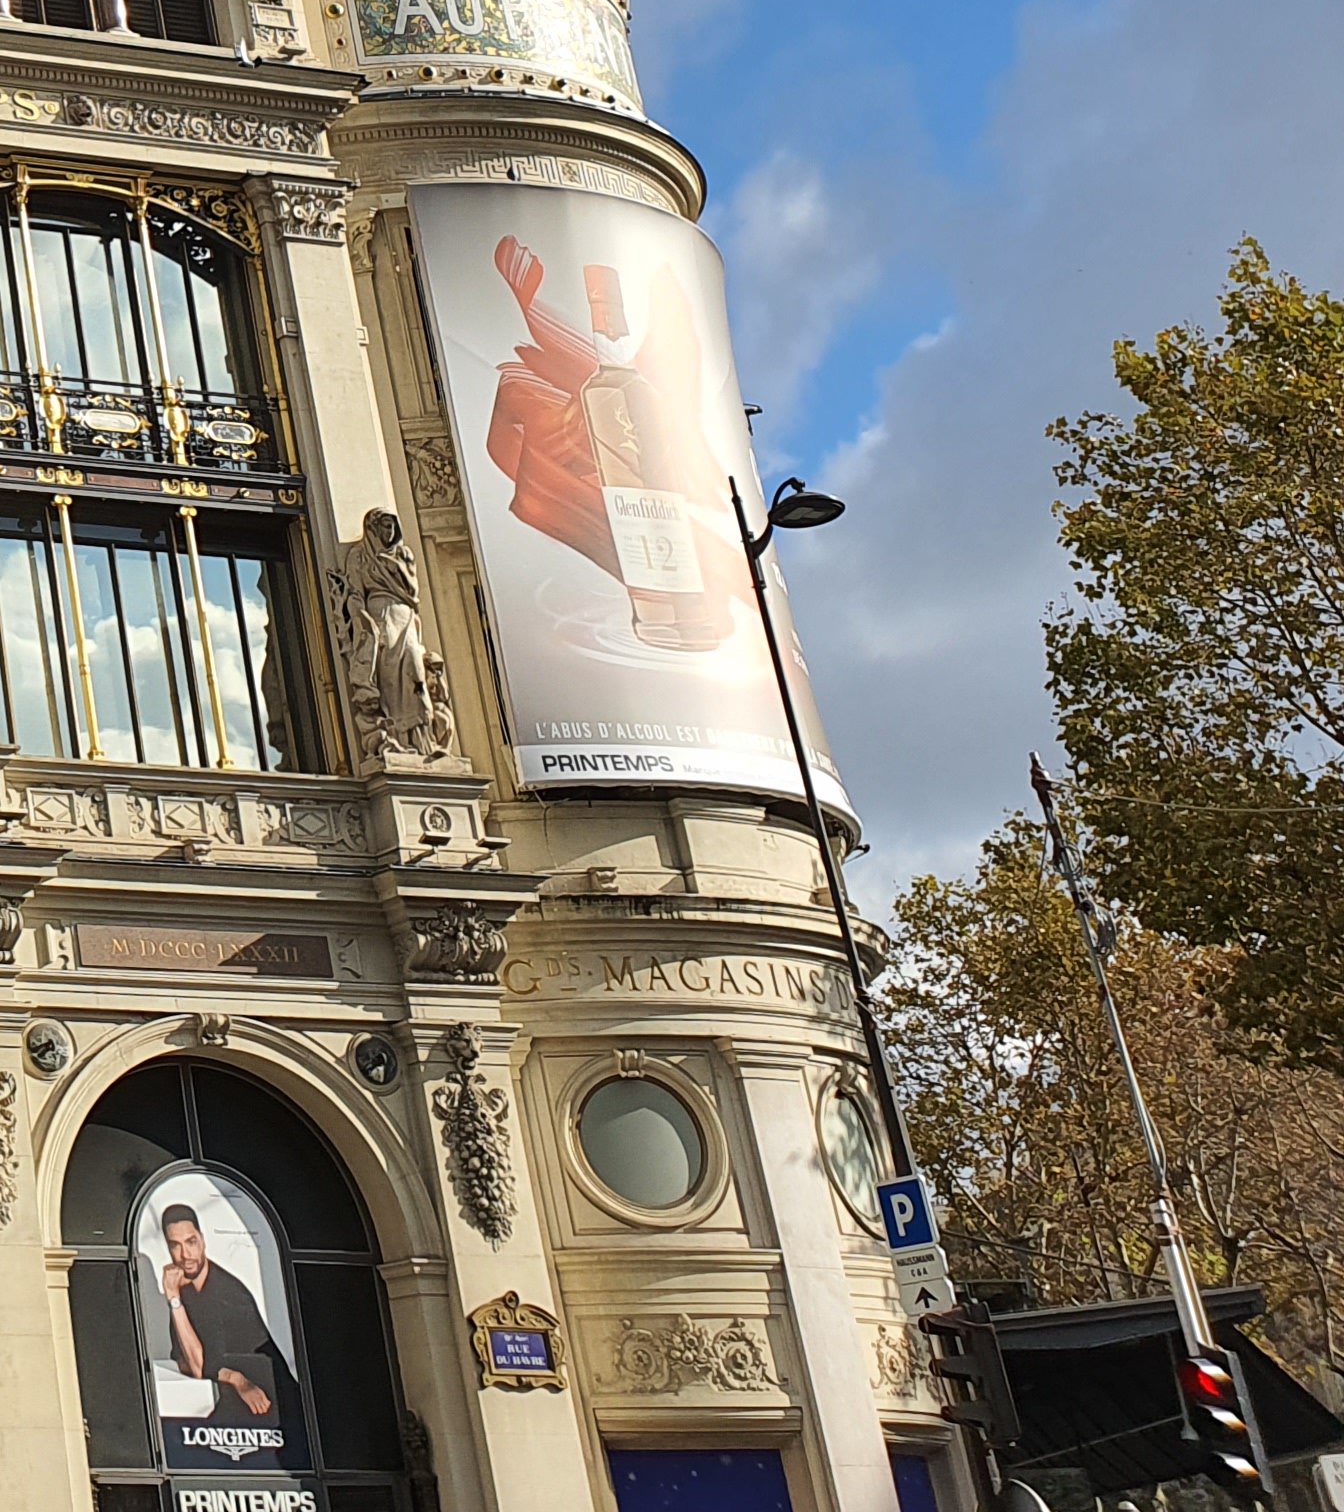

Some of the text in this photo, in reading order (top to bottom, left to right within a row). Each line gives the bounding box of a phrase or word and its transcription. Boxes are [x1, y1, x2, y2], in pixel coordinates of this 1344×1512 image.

[535, 721, 592, 739] L'ABUS
[598, 722, 672, 742] D'ALCOOL
[676, 725, 701, 743] EST
[541, 754, 674, 773] PRINTEMPS
[599, 955, 826, 1005] MAGASINS
[889, 1192, 914, 1237] P
[506, 1344, 530, 1354] RUE
[181, 1427, 284, 1447] LONGINES
[178, 1490, 317, 1512] PRINTEMPS
